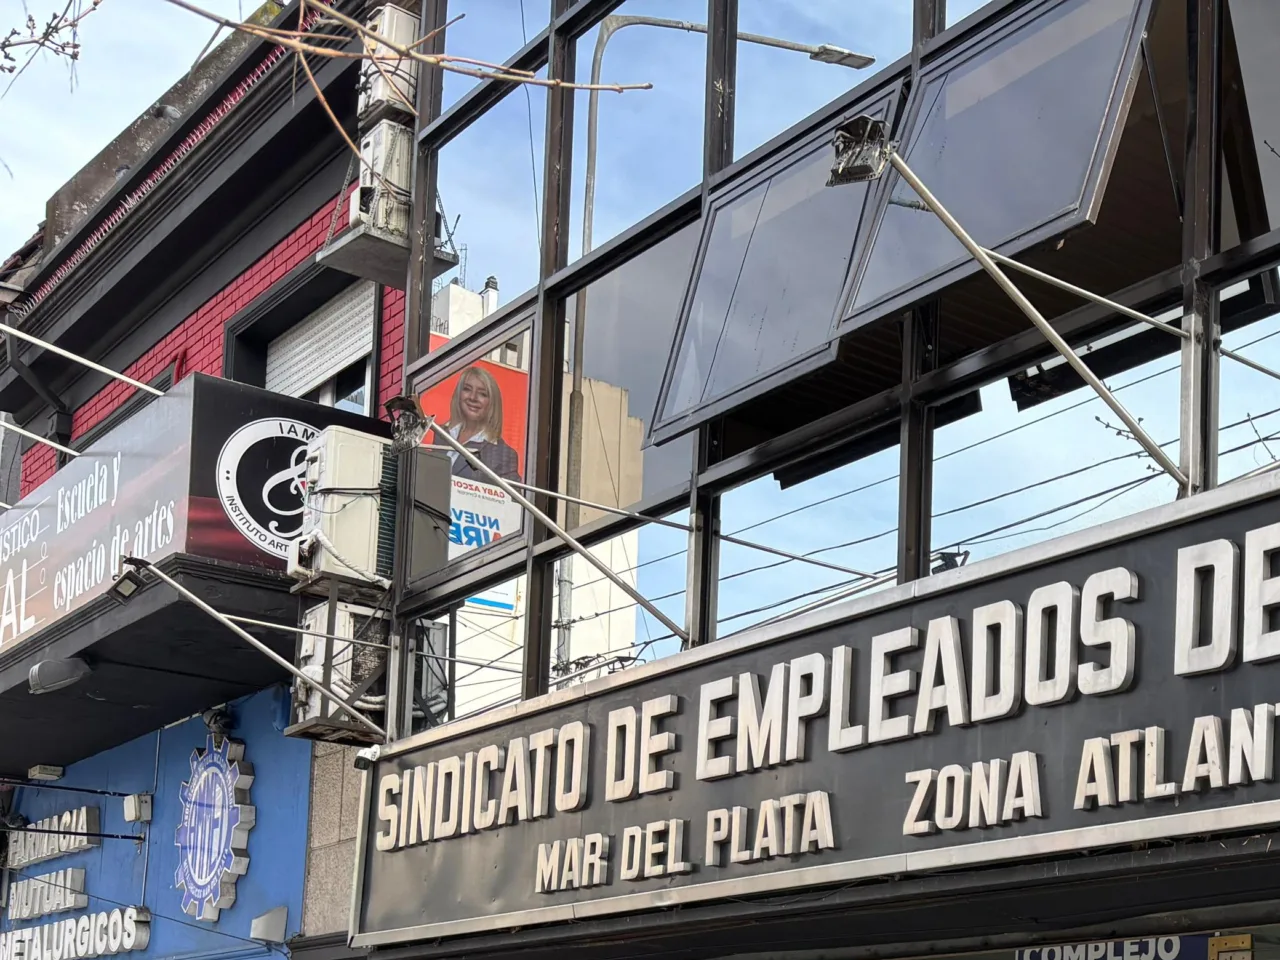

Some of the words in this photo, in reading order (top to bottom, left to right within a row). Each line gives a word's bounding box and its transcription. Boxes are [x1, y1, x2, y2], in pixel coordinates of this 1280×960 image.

[57, 462, 108, 534] Escuela
[112, 451, 121, 506] y
[226, 495, 267, 543] INSTITUTO
[53, 540, 105, 612] espacio
[112, 525, 129, 576] de
[134, 500, 174, 557] artes
[376, 721, 589, 852] SINDICATO
[606, 694, 679, 801] DE
[696, 568, 1139, 781] EMPLEADOS
[8, 806, 88, 868] FARMACIA
[535, 833, 609, 892] MAR
[620, 818, 692, 880] DEL
[706, 790, 835, 866] PLATA
[903, 751, 1041, 836] ZONA
[8, 868, 76, 920] MUTUAL
